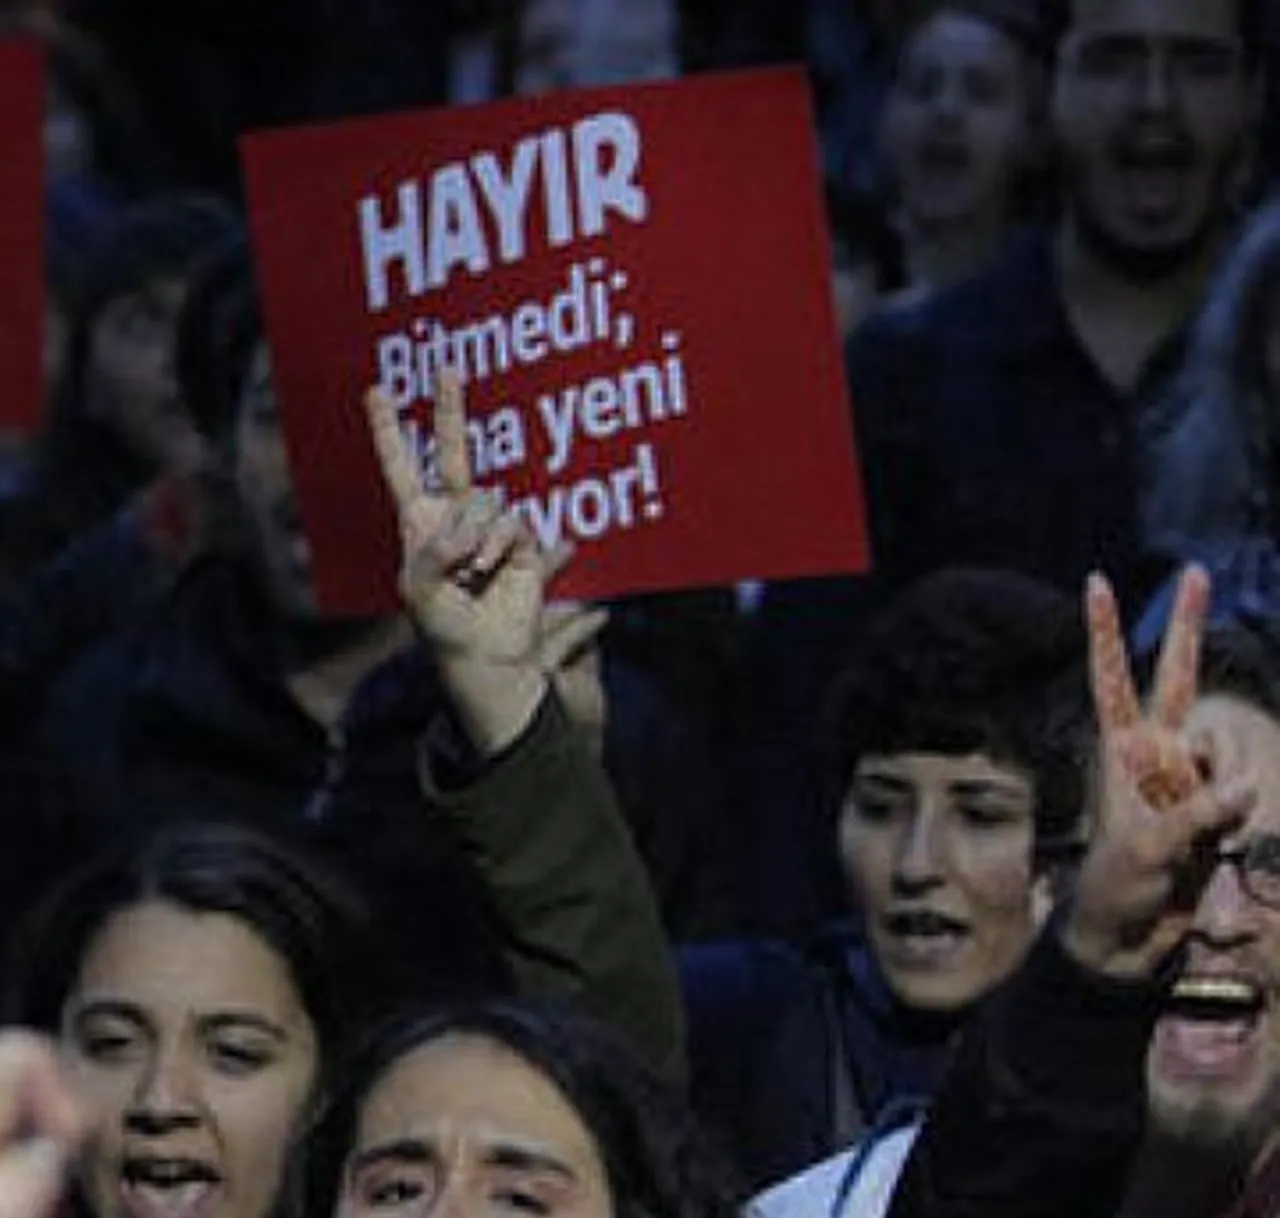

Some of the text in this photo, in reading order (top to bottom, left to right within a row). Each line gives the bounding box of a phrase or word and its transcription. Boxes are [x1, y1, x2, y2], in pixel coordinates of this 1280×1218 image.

[358, 109, 648, 312] HAYIR
[374, 258, 636, 408] Bitmedi;
[537, 328, 688, 476] yeni
